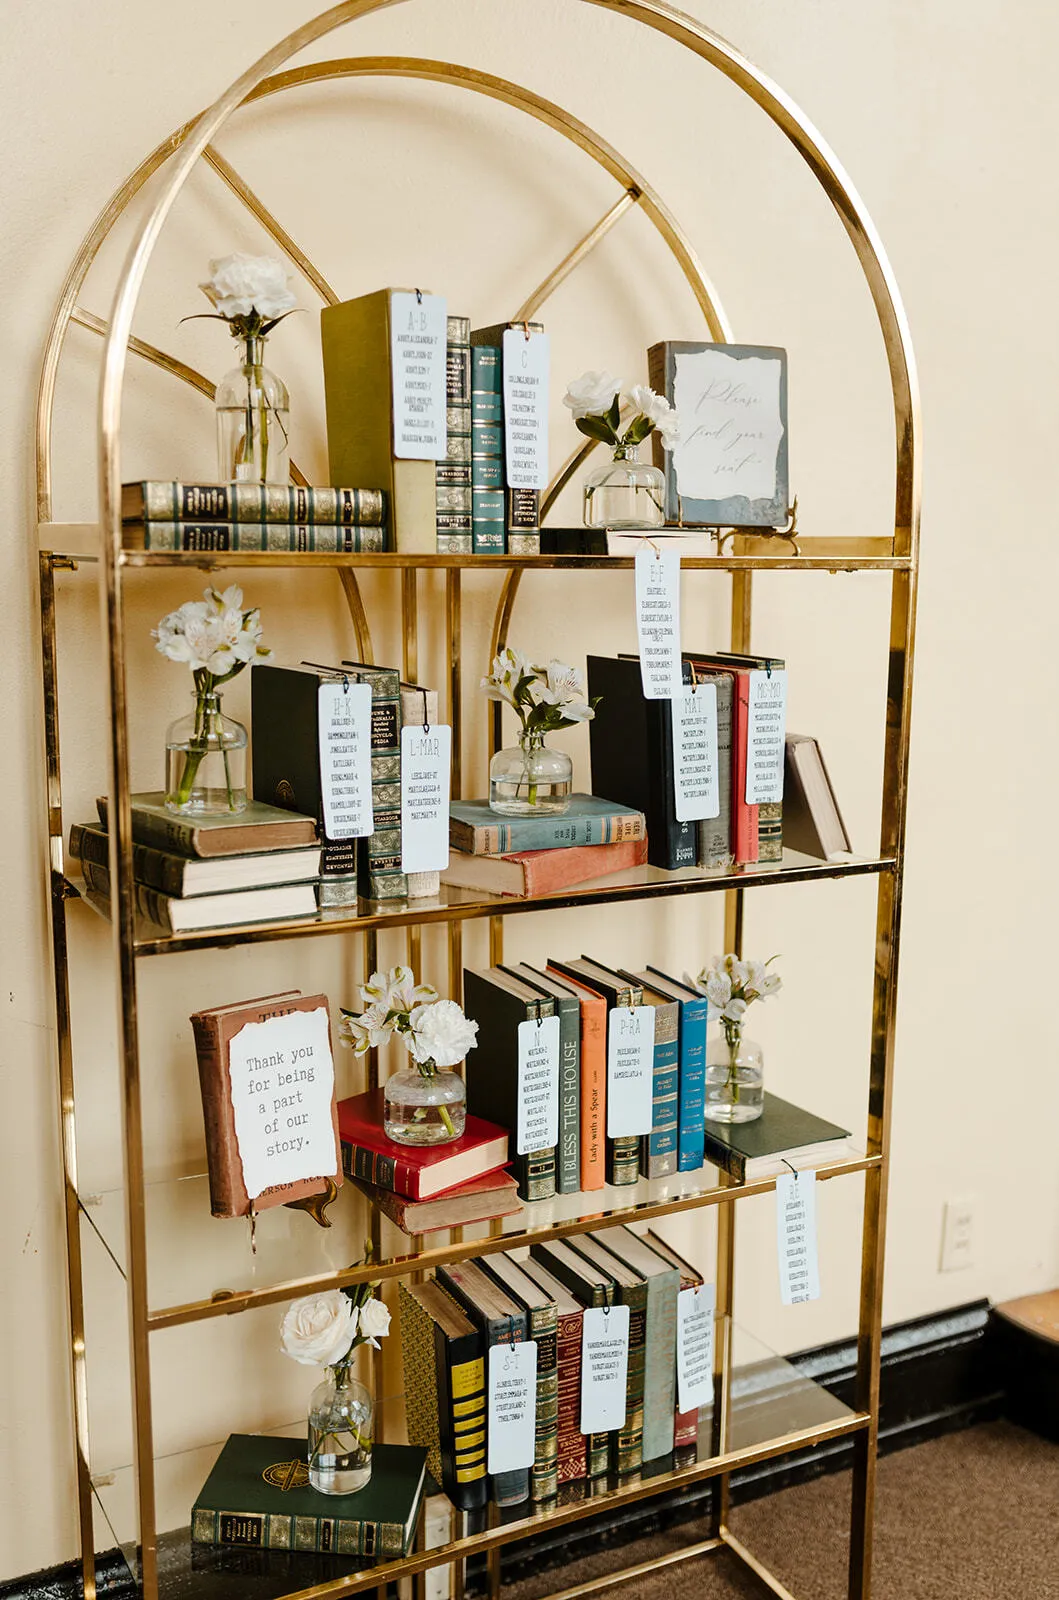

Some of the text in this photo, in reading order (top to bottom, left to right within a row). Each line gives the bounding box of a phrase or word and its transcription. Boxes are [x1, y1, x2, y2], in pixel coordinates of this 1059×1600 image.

[695, 377, 762, 414] Please
[683, 419, 766, 451] find your
[684, 697, 703, 714] MAT
[410, 739, 440, 758] L-MAR
[246, 1046, 314, 1073] Thank you
[247, 1067, 315, 1095] for being
[258, 1091, 303, 1114] a part
[563, 1040, 577, 1172] BLESS THIS HOUSE
[590, 1089, 600, 1112] Spear
[264, 1112, 309, 1135] of our
[589, 1121, 598, 1141] with
[266, 1139, 311, 1157] story.
[589, 1142, 599, 1163] Lady
